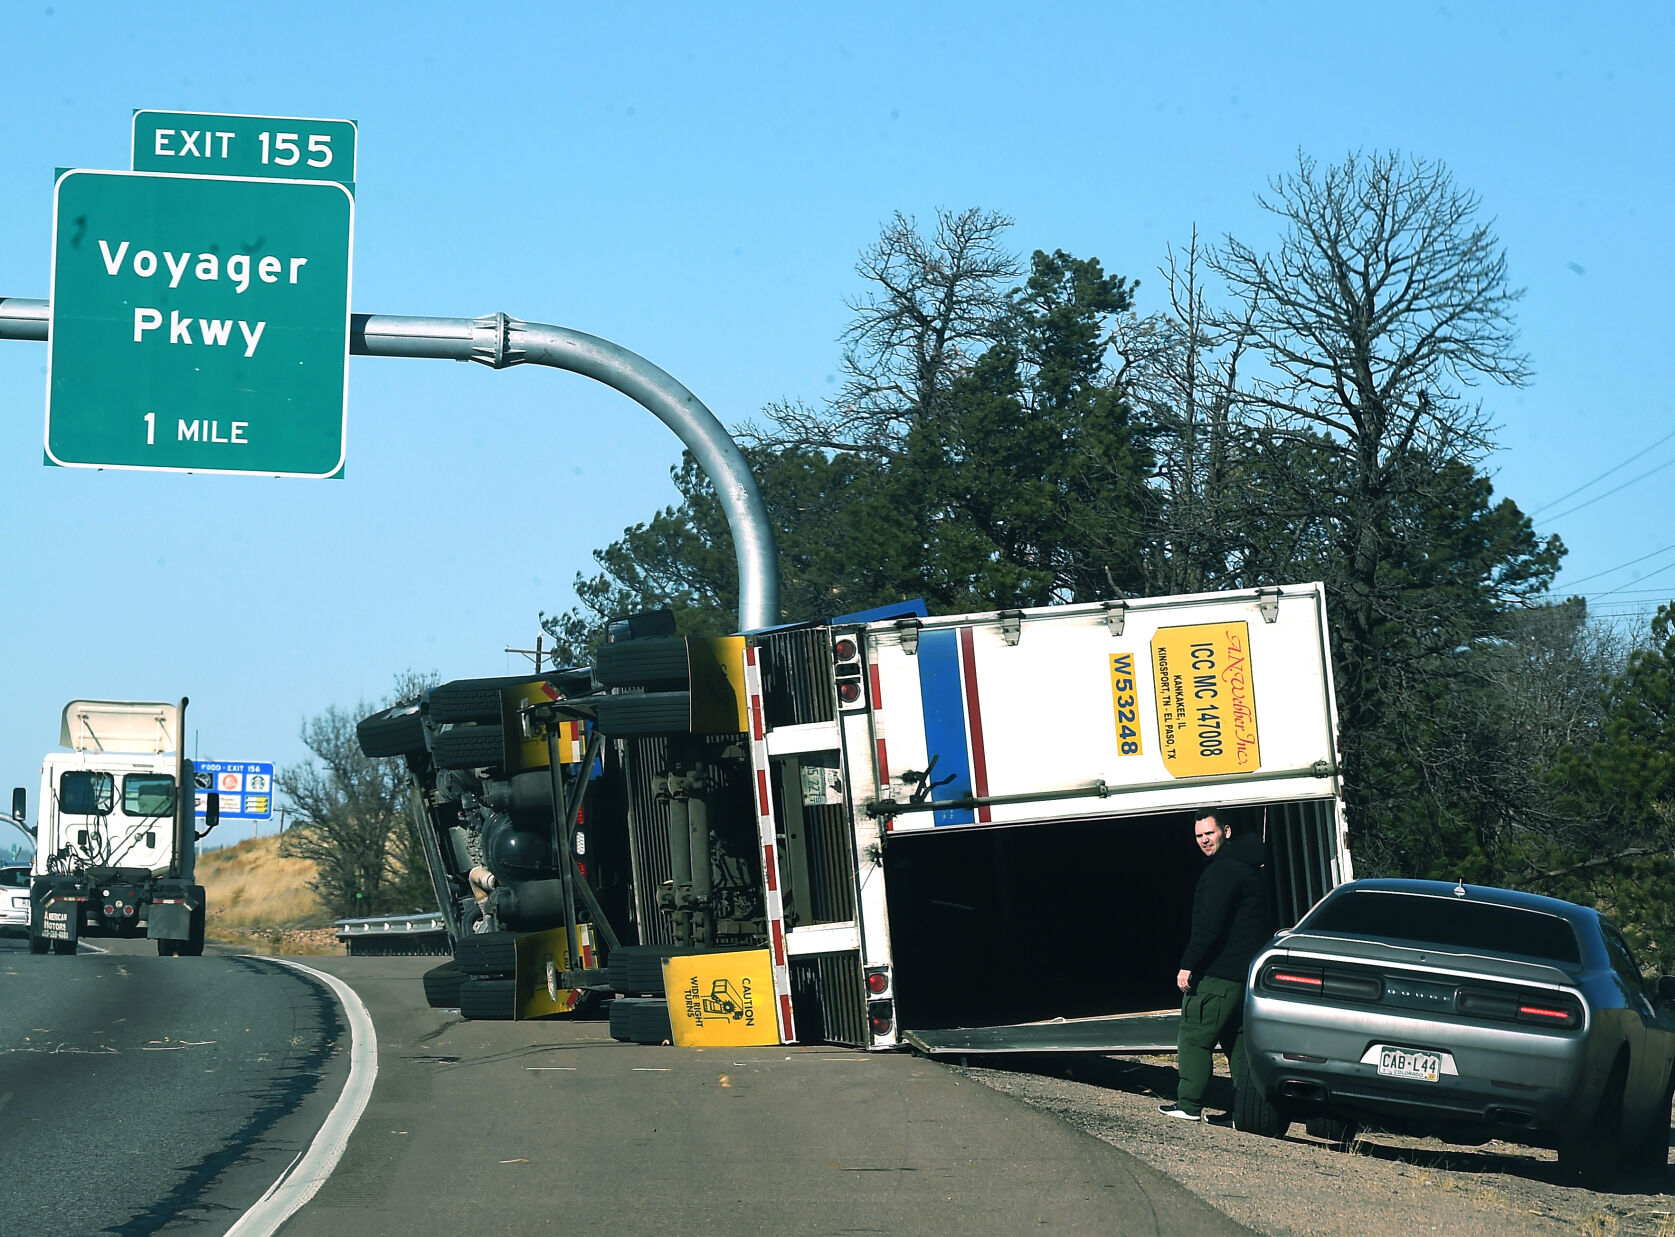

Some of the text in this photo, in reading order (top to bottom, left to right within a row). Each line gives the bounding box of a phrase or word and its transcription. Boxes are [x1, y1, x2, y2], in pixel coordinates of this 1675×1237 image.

[154, 128, 333, 168] EXIT 155
[98, 240, 308, 293] Voyager
[133, 307, 266, 357] Pkwy
[144, 412, 249, 445] 1 MILE
[1158, 647, 1171, 694] KINGSPORT,
[1113, 654, 1139, 755] W53248
[1162, 695, 1172, 706] TN
[1163, 712, 1173, 723] EL
[1173, 674, 1187, 730] KANKAKEE, IL
[1190, 643, 1224, 757] ICC MC 147008
[1230, 672, 1253, 731] Webber
[1165, 725, 1176, 747] PASO,
[1168, 749, 1177, 760] TX
[684, 990, 695, 1018] TURNS
[690, 976, 704, 1028] WIDE RIGHT
[741, 977, 755, 1027] CAUTION
